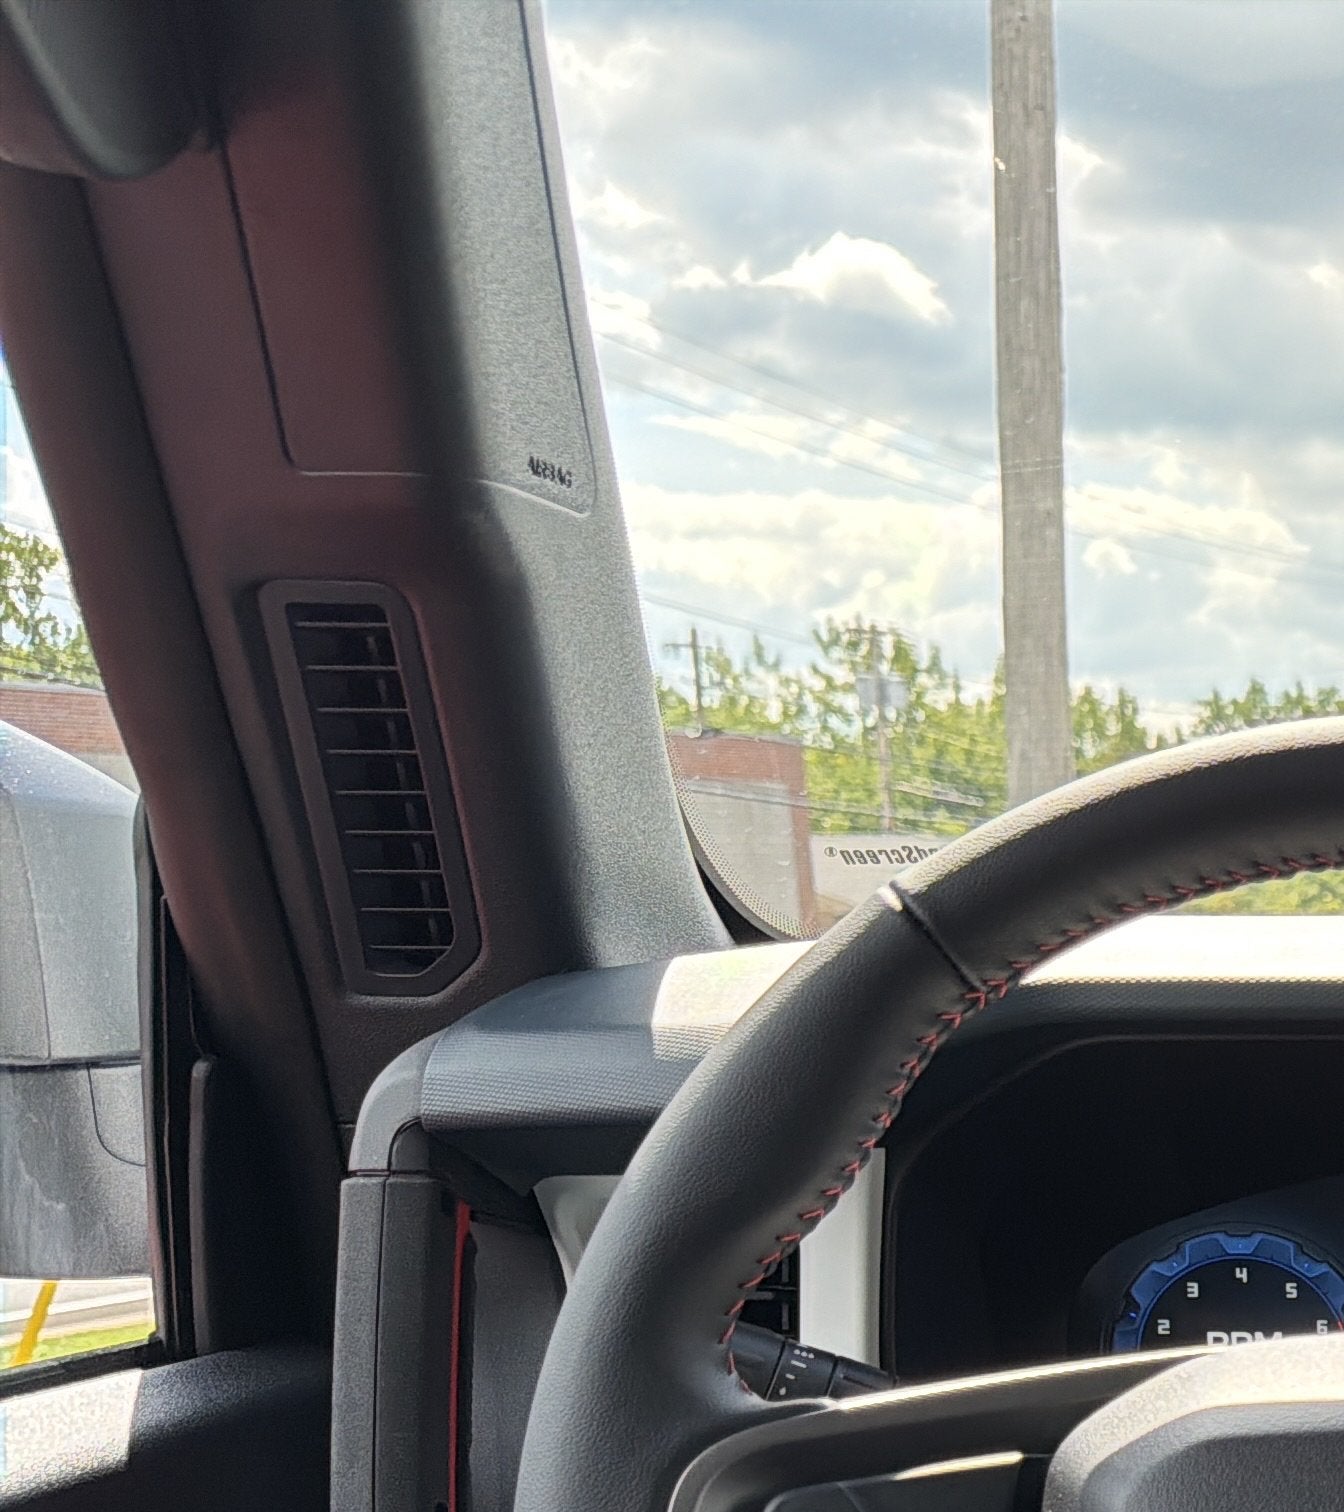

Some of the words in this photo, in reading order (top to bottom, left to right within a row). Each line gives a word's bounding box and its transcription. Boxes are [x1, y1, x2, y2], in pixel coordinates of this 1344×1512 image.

[1235, 1267, 1249, 1284] 4
[1186, 1282, 1200, 1298] 3
[1285, 1282, 1298, 1299] 5
[1157, 1319, 1171, 1335] 2
[1316, 1319, 1329, 1335] 6
